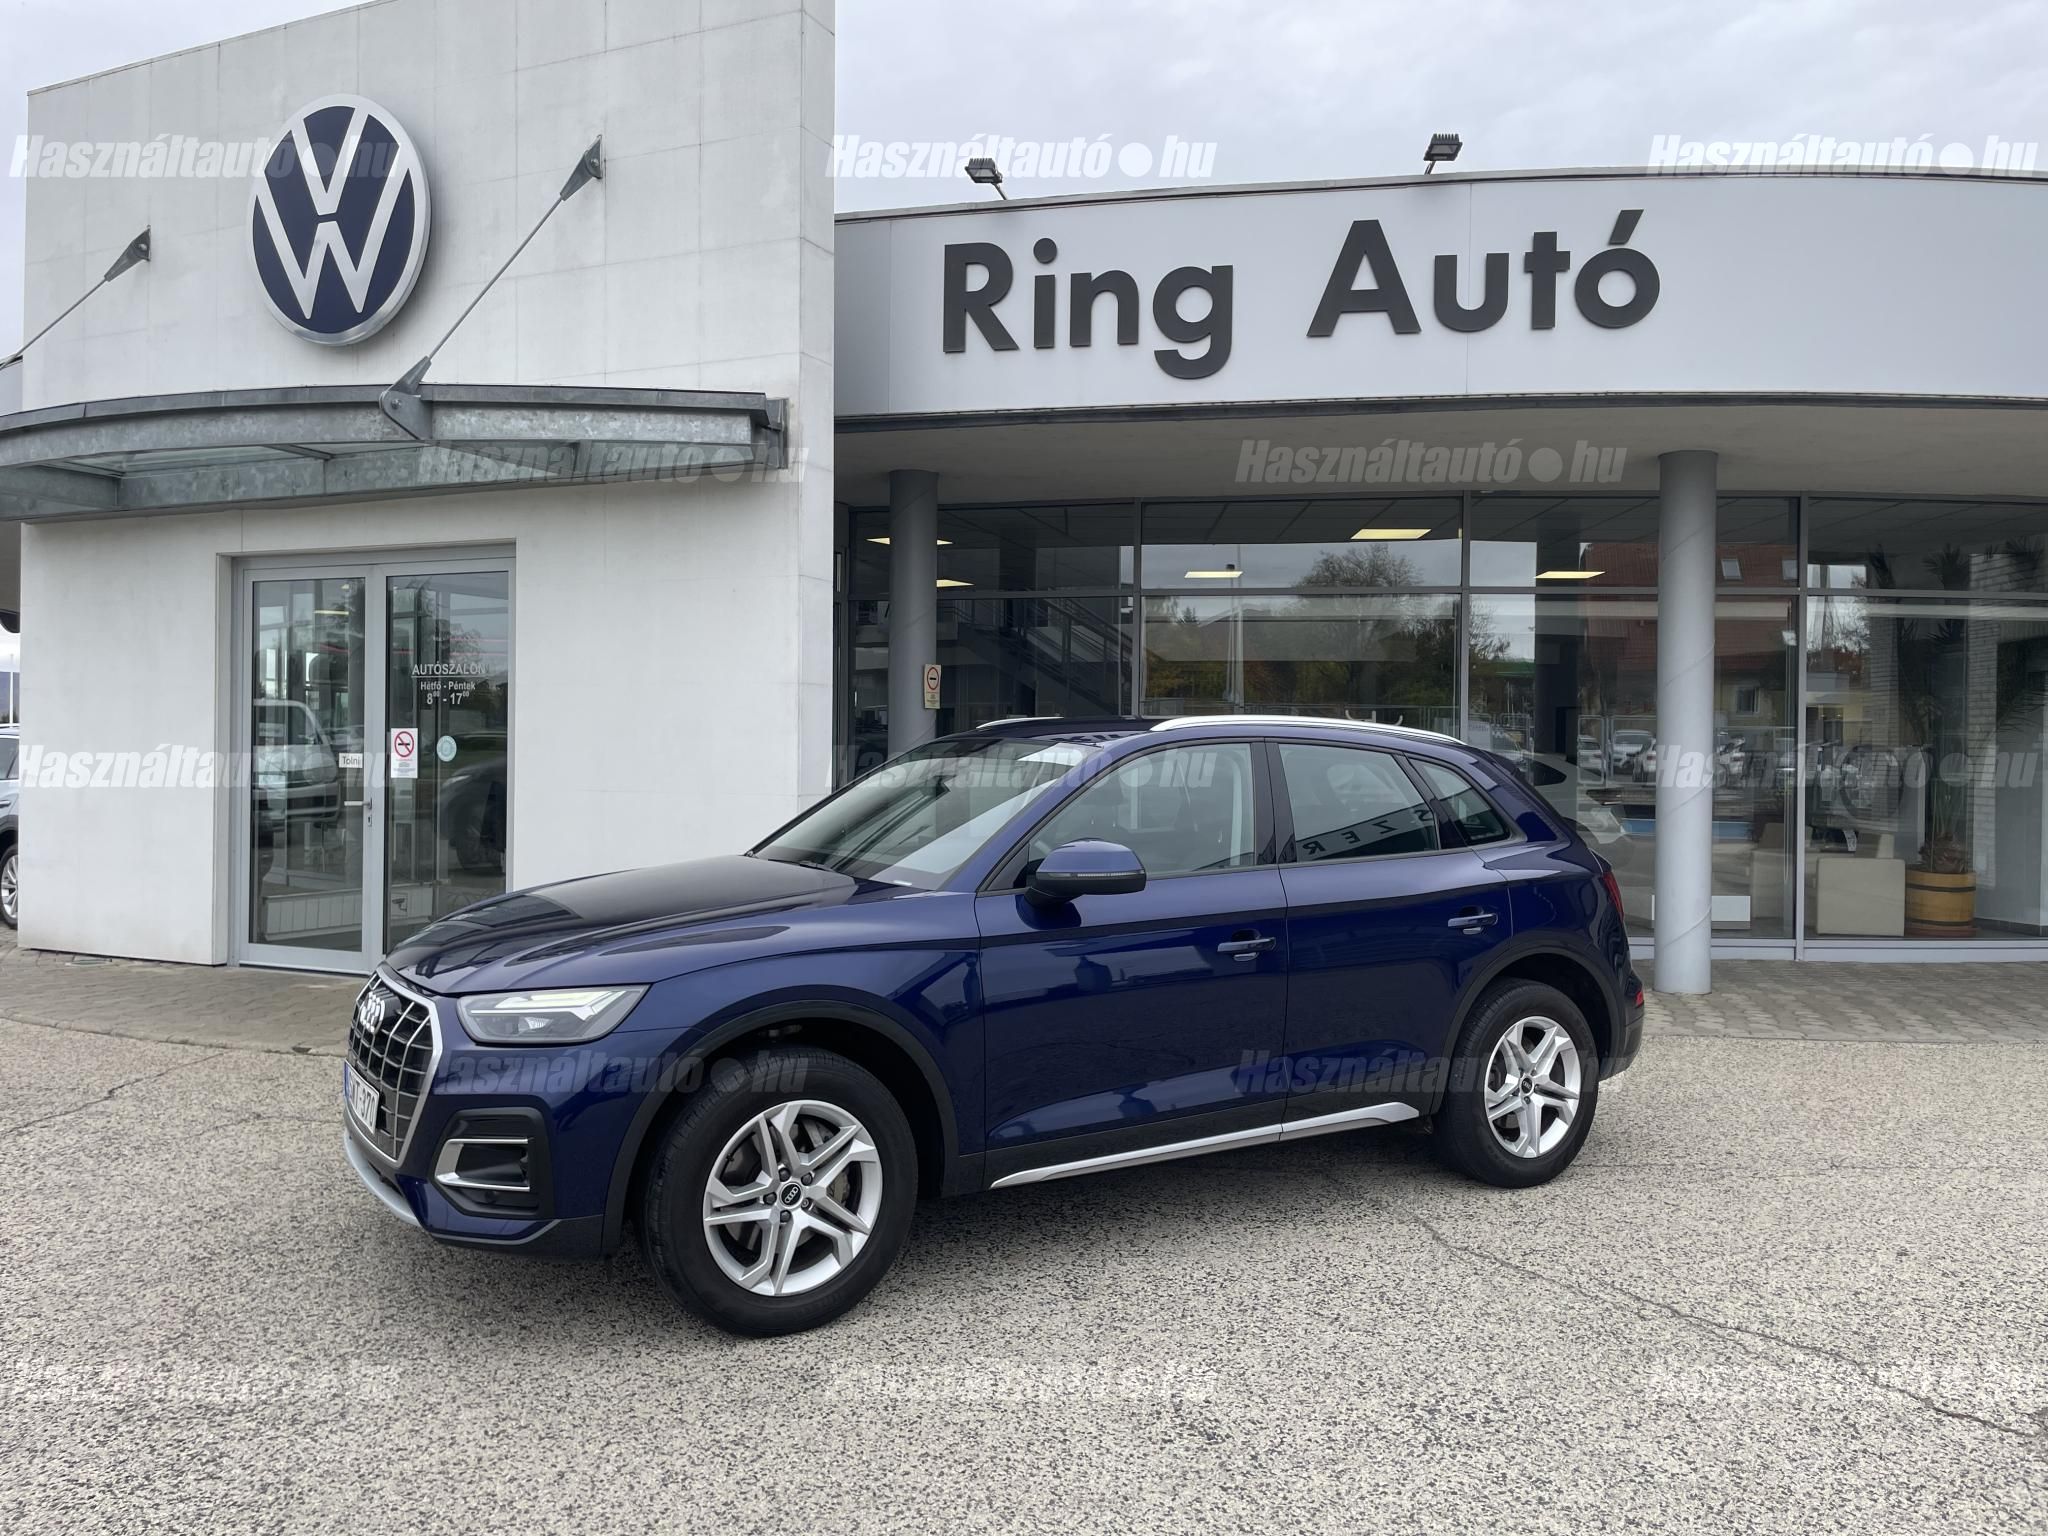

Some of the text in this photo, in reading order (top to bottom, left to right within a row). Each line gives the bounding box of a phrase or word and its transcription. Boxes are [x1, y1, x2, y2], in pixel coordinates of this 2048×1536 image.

[943, 209, 1660, 380] Ring Autó
[343, 756, 360, 765] Tolni
